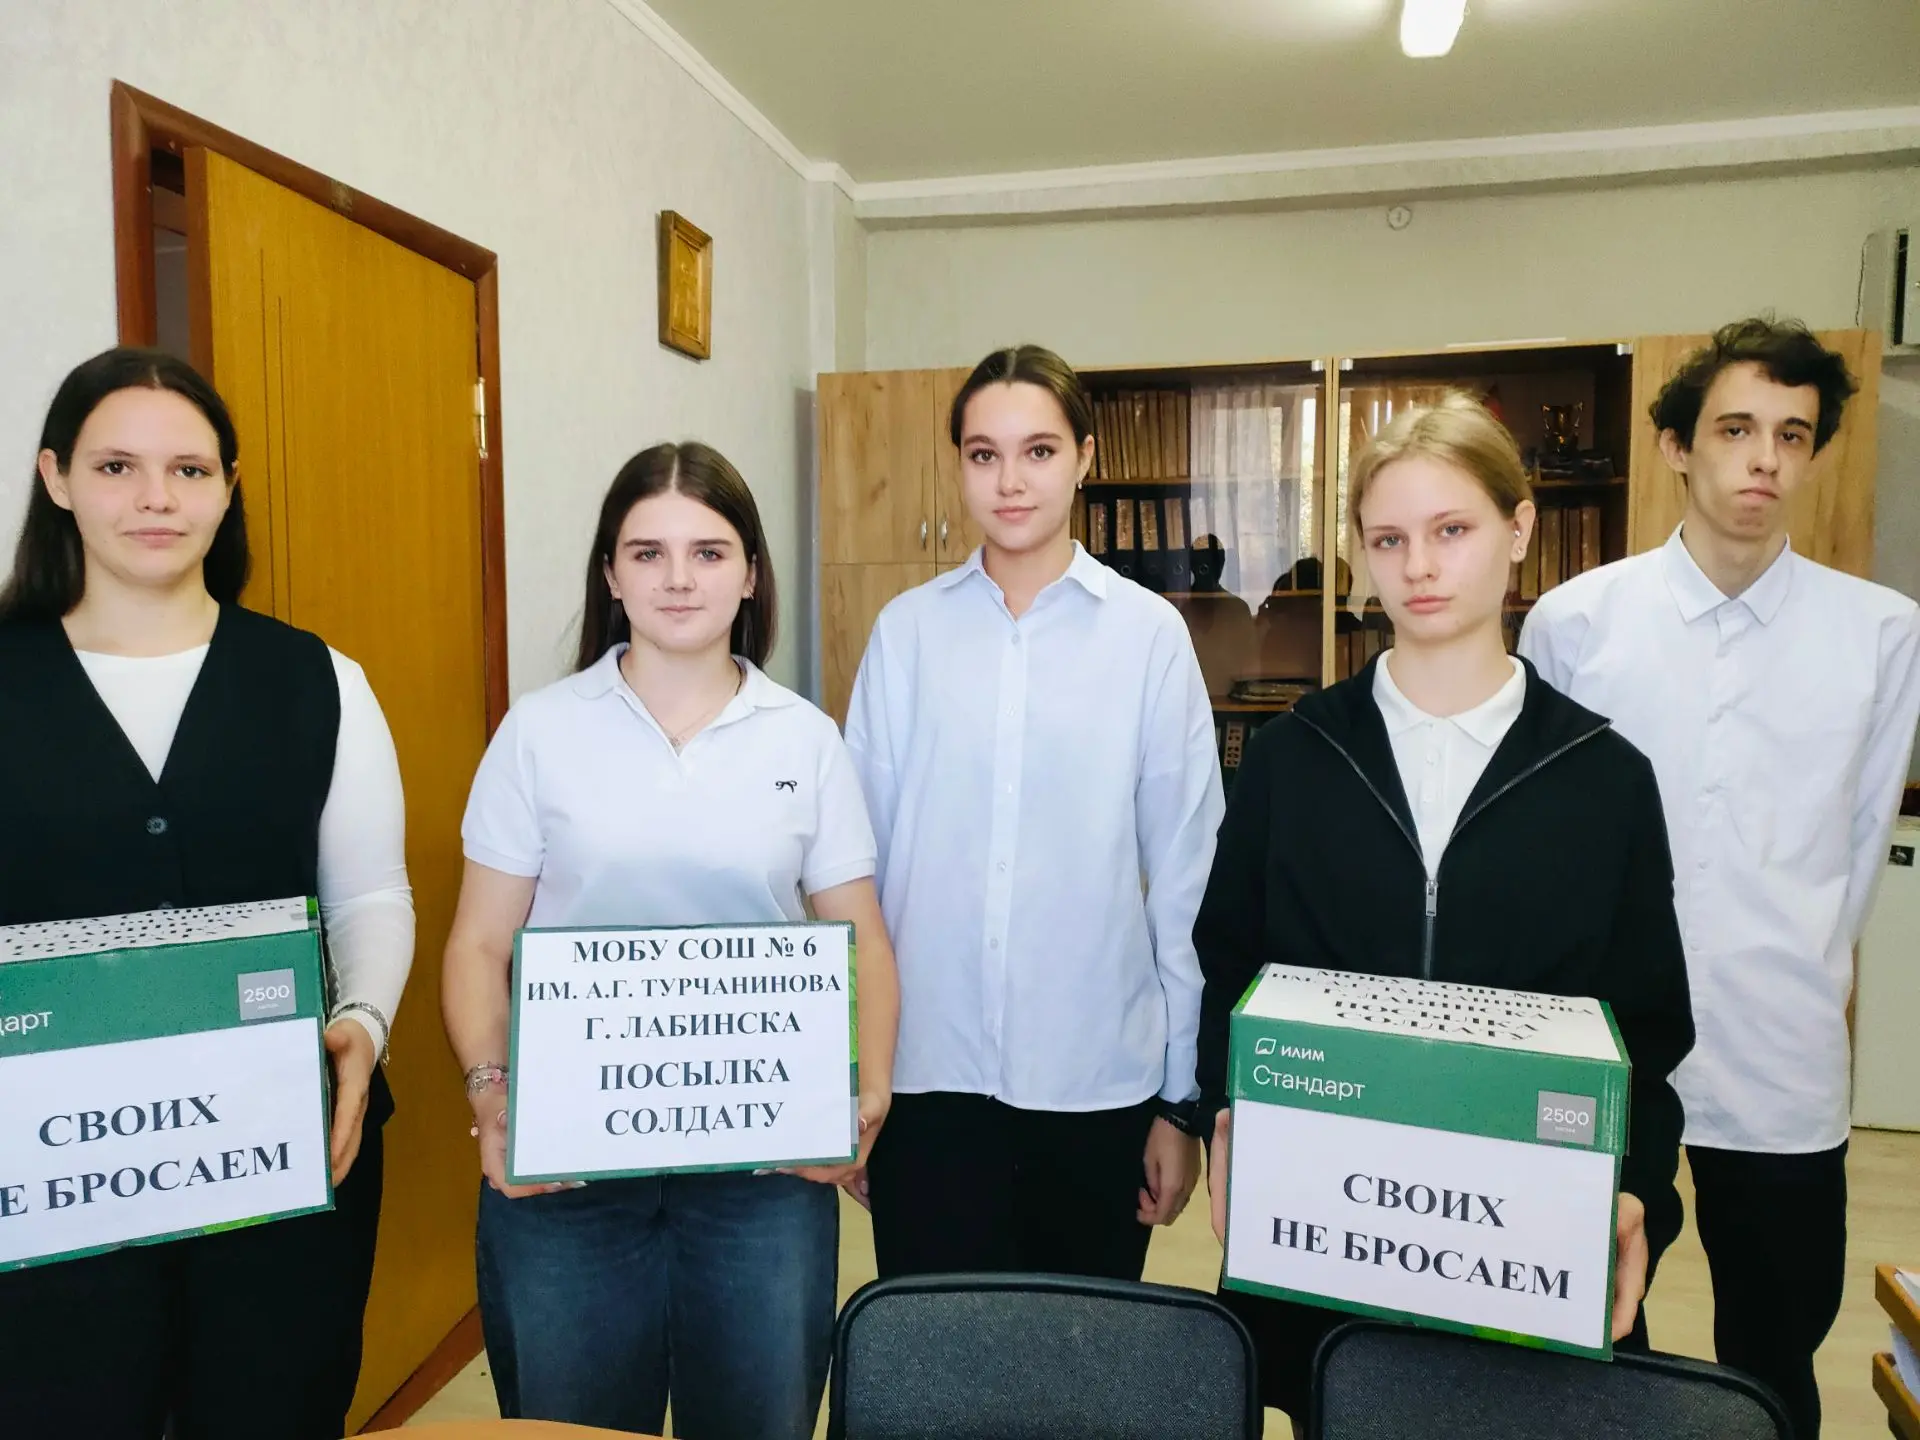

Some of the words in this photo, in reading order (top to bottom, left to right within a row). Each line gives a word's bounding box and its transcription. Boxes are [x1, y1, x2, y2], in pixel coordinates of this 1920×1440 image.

[573, 939, 668, 963] МОБУ
[678, 937, 755, 960] СОШ
[765, 936, 794, 958] №
[803, 936, 817, 957] 6
[243, 985, 290, 1003] 2500
[528, 981, 577, 1001] ИМ.
[586, 980, 633, 999] А.Г.
[641, 974, 841, 997] ТУРЧАНИНОВА
[0, 1011, 53, 1036] арт
[585, 1017, 611, 1040] Г.
[620, 1011, 802, 1039] ЛАБИНСКА
[599, 1058, 790, 1091] ПОСЫЛКА
[1252, 1064, 1366, 1101] Стандарт
[39, 1094, 220, 1147] СВОИХ
[605, 1101, 784, 1137] СОЛДАТУ
[1542, 1106, 1590, 1126] 2500
[44, 1141, 291, 1210] БРОСАЕМ
[1343, 1173, 1506, 1228] СВОИХ
[1271, 1216, 1329, 1255] НЕ
[1343, 1230, 1573, 1300] БРОСАЕМ
